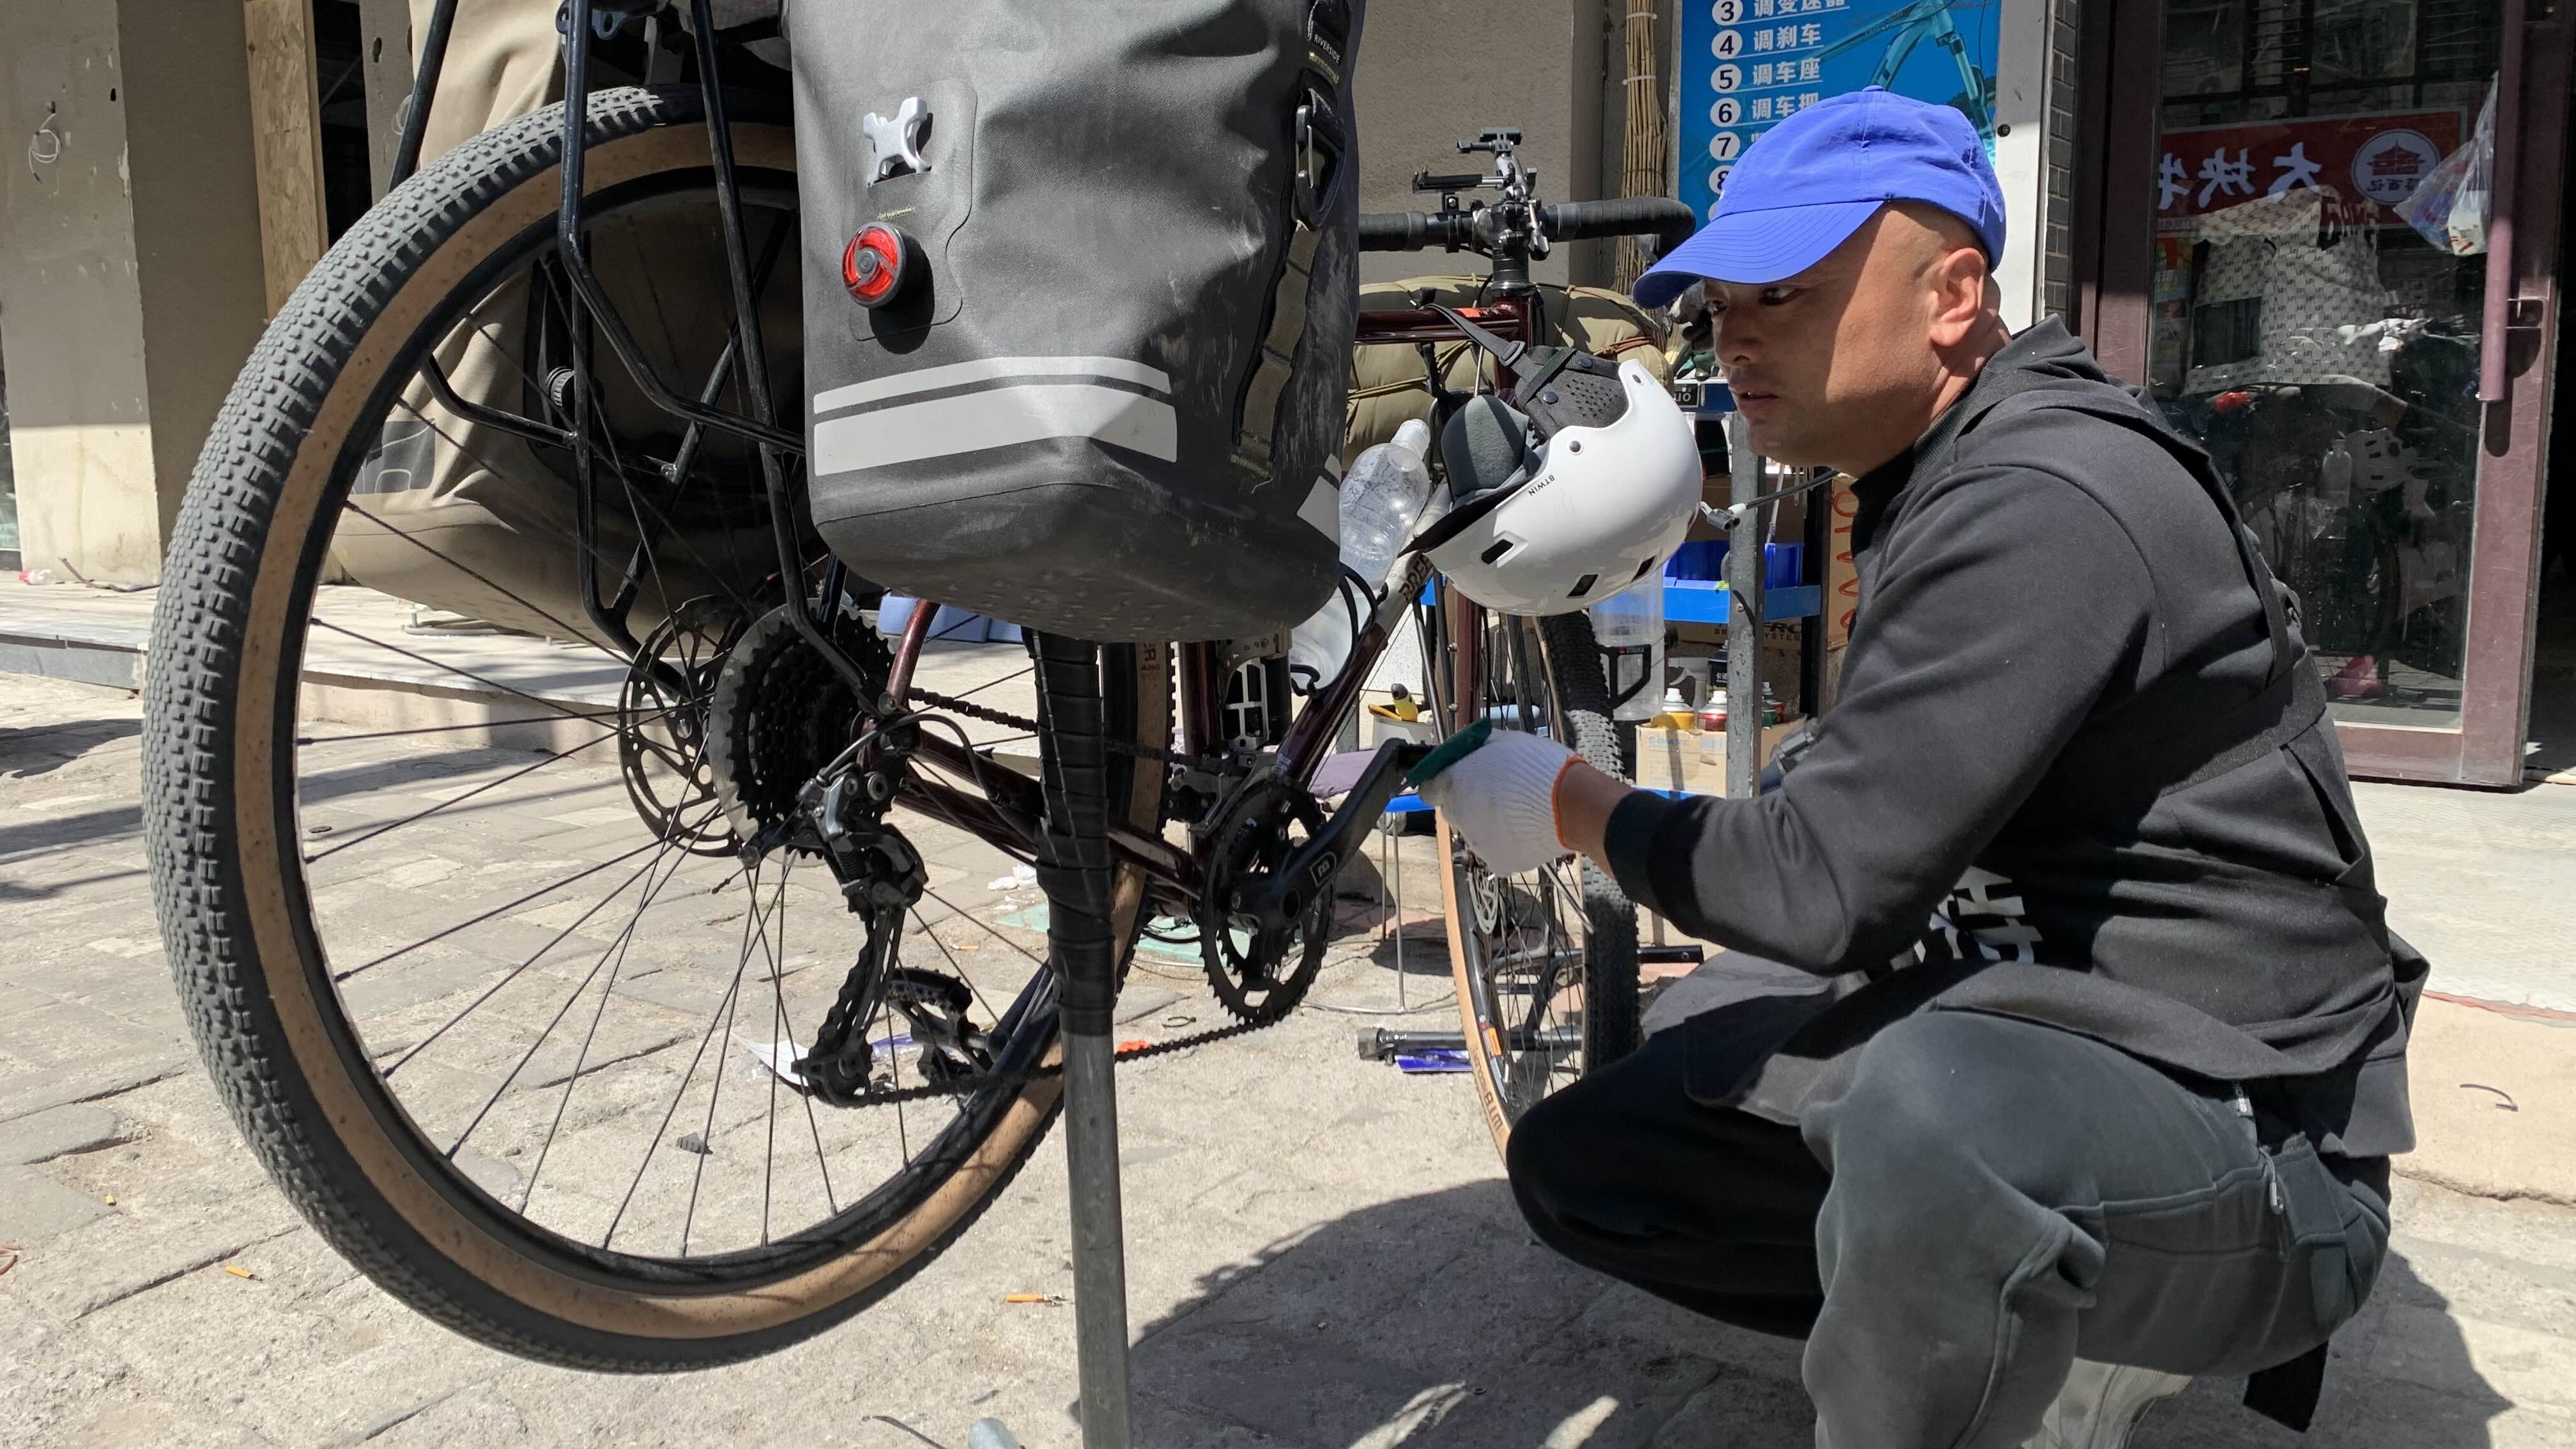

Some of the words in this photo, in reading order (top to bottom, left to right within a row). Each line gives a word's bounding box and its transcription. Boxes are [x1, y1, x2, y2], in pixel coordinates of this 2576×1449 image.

[1721, 1, 1735, 22] 3
[1314, 34, 1340, 64] RIVERSIDE
[1719, 35, 1734, 55] 4
[1753, 23, 1821, 52] 调刹车
[1719, 69, 1733, 89] 5
[1752, 57, 1821, 86] 调车座
[1719, 103, 1733, 123] 6
[1717, 137, 1731, 157] 7
[1528, 475, 1555, 496] BTWIN
